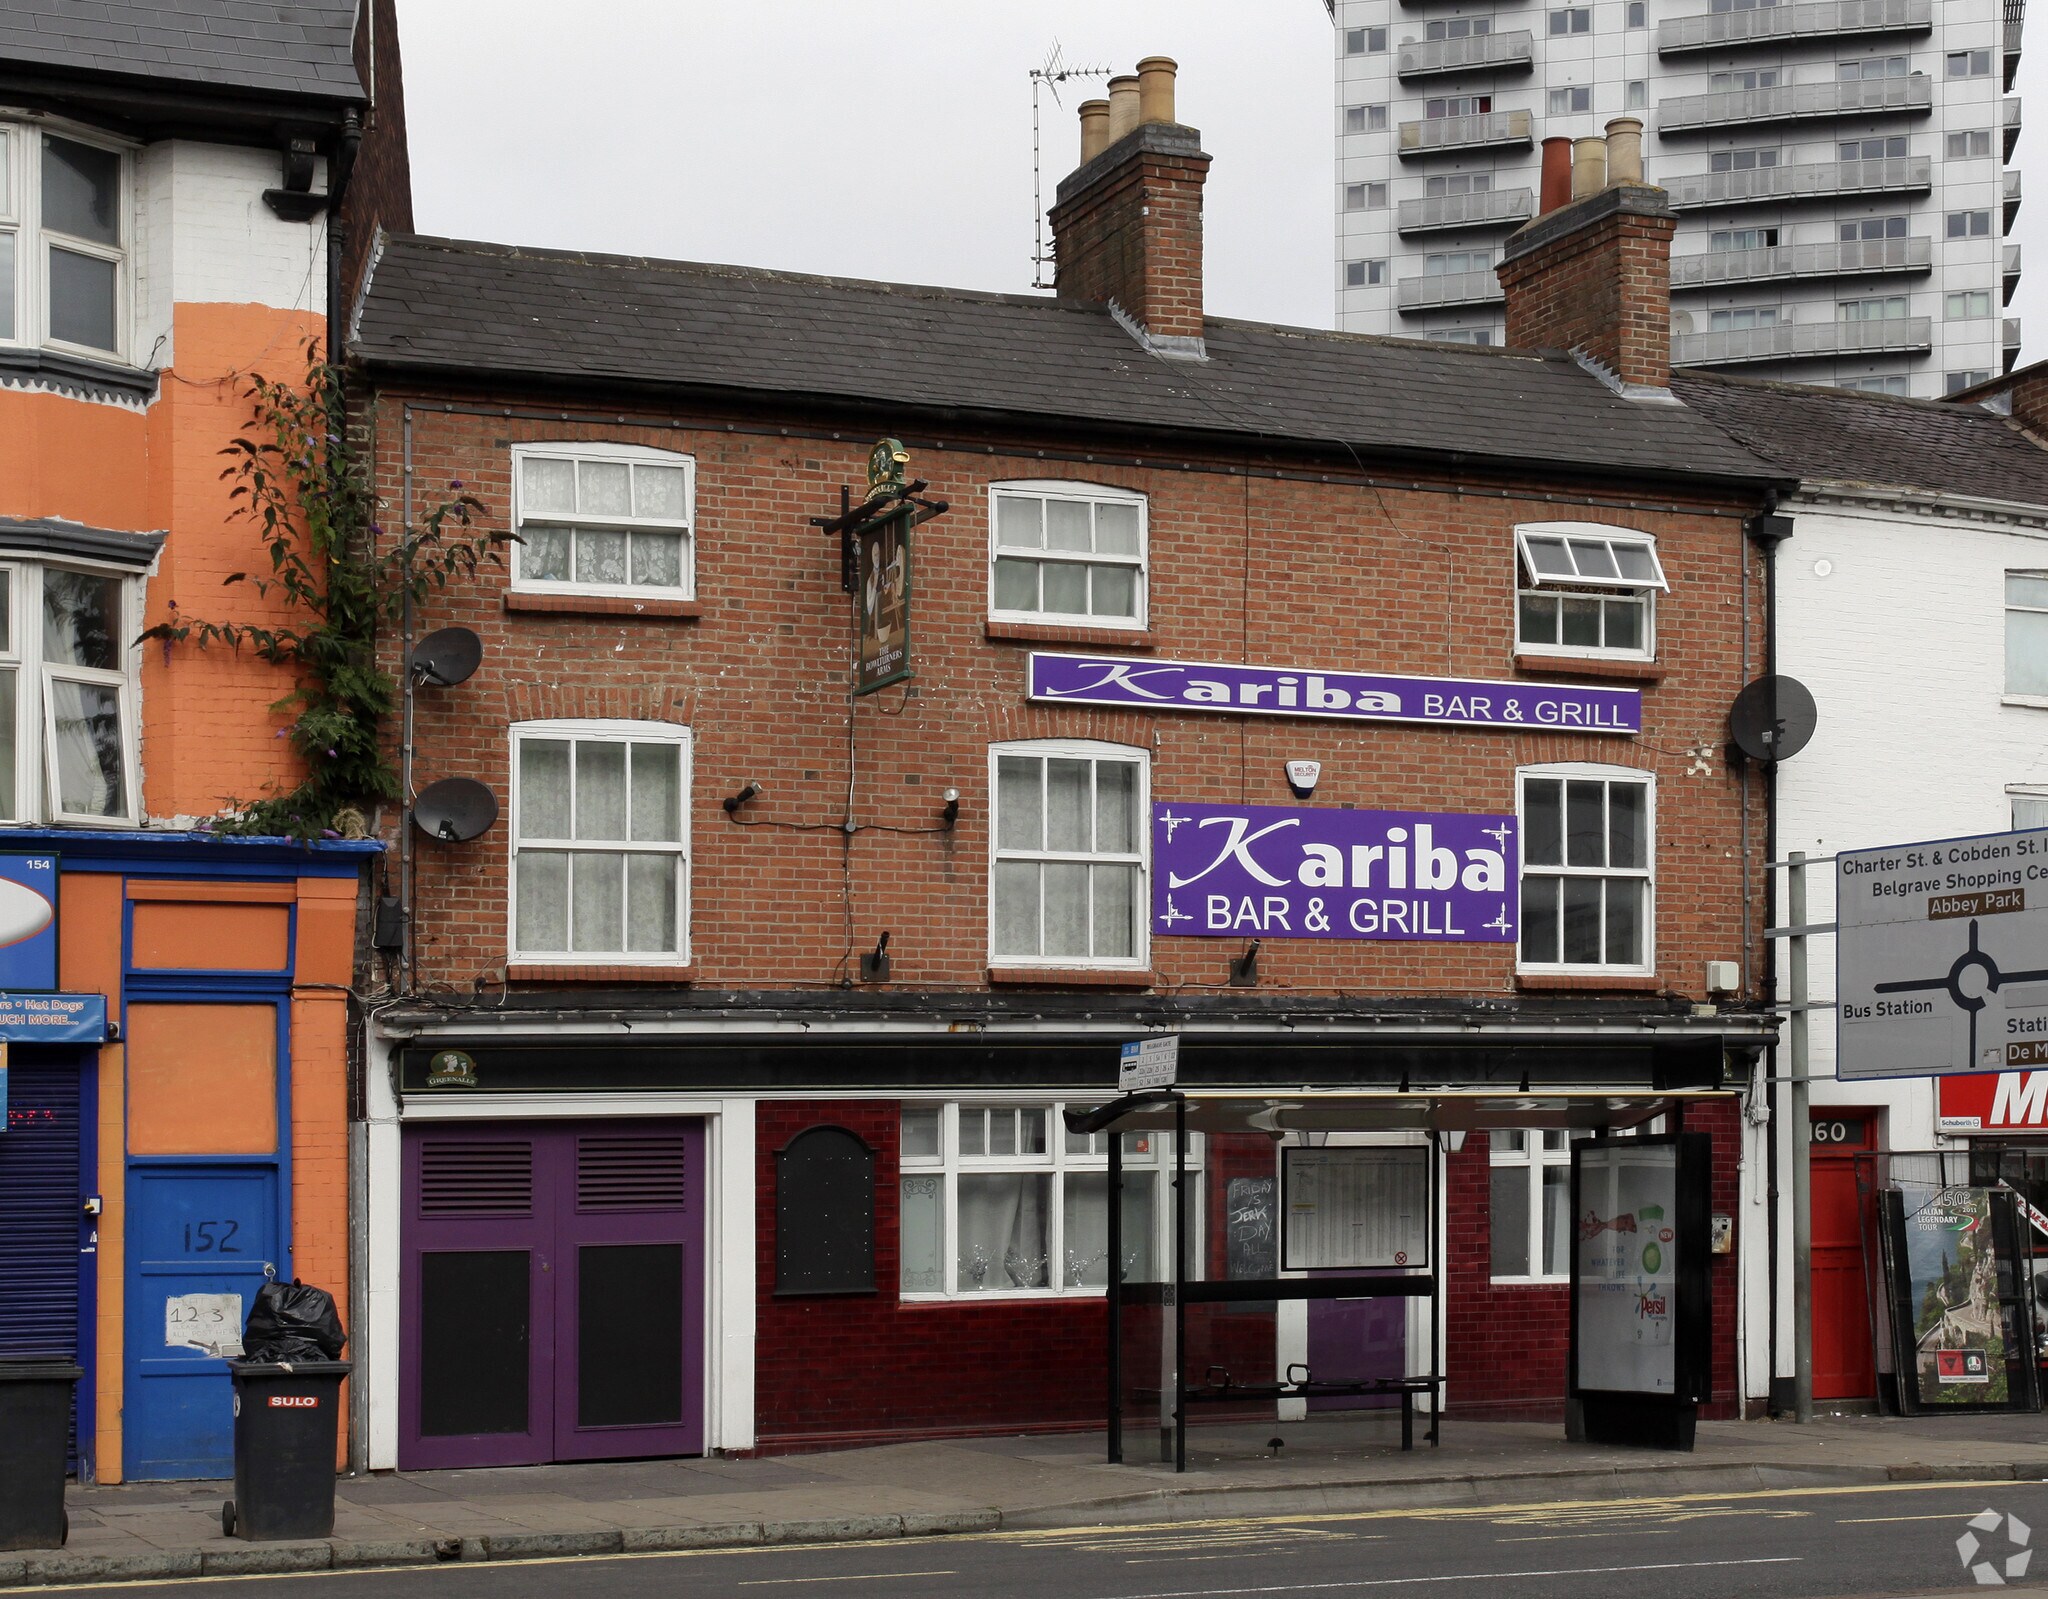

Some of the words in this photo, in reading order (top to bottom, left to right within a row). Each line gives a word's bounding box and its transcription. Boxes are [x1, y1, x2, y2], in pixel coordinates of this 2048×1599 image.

[879, 645, 890, 657] THE
[866, 649, 903, 672] BOWLTURNERS
[876, 664, 891, 677] ARMS
[1046, 663, 1402, 713] Kariba
[1424, 694, 1492, 719] BAR
[1502, 699, 1524, 722] &
[1535, 701, 1629, 727] GRILL
[1168, 815, 1506, 893] Kariba
[1843, 858, 1901, 876] Charter
[1906, 853, 1928, 869] St.
[1932, 850, 1943, 865] &
[1948, 845, 2011, 864] Cobden
[2016, 839, 2039, 856] St.
[26, 860, 50, 869] 154
[1872, 879, 1942, 897] Belgrave
[1946, 868, 2022, 889] Shopping
[1931, 897, 1979, 915] Abbey
[1985, 891, 2021, 909] Park
[1207, 894, 1292, 932] BAR
[1304, 897, 1331, 932] &
[1349, 898, 1465, 935] GRILL
[25, 999, 49, 1010] Hot
[51, 1000, 84, 1012] Dogs
[1843, 1004, 1871, 1019] Bus
[1876, 1000, 1933, 1016] Station
[28, 1014, 79, 1026] MORE...
[2009, 1044, 2030, 1060] De
[429, 1076, 475, 1085] GREENALLS
[1989, 1070, 2048, 1124] M
[1233, 1182, 1273, 1198] FRIDAY
[1230, 1206, 1267, 1224] JERK
[1917, 1208, 1944, 1216] ITALIAN
[1918, 1216, 1958, 1224] LEGENDARY
[184, 1220, 242, 1252] 152
[1238, 1219, 1273, 1242] DAY
[1243, 1242, 1268, 1257] ALL
[1598, 1283, 1626, 1292] THROWS
[1641, 1296, 1666, 1319] Persil
[271, 1396, 316, 1406] SULO
